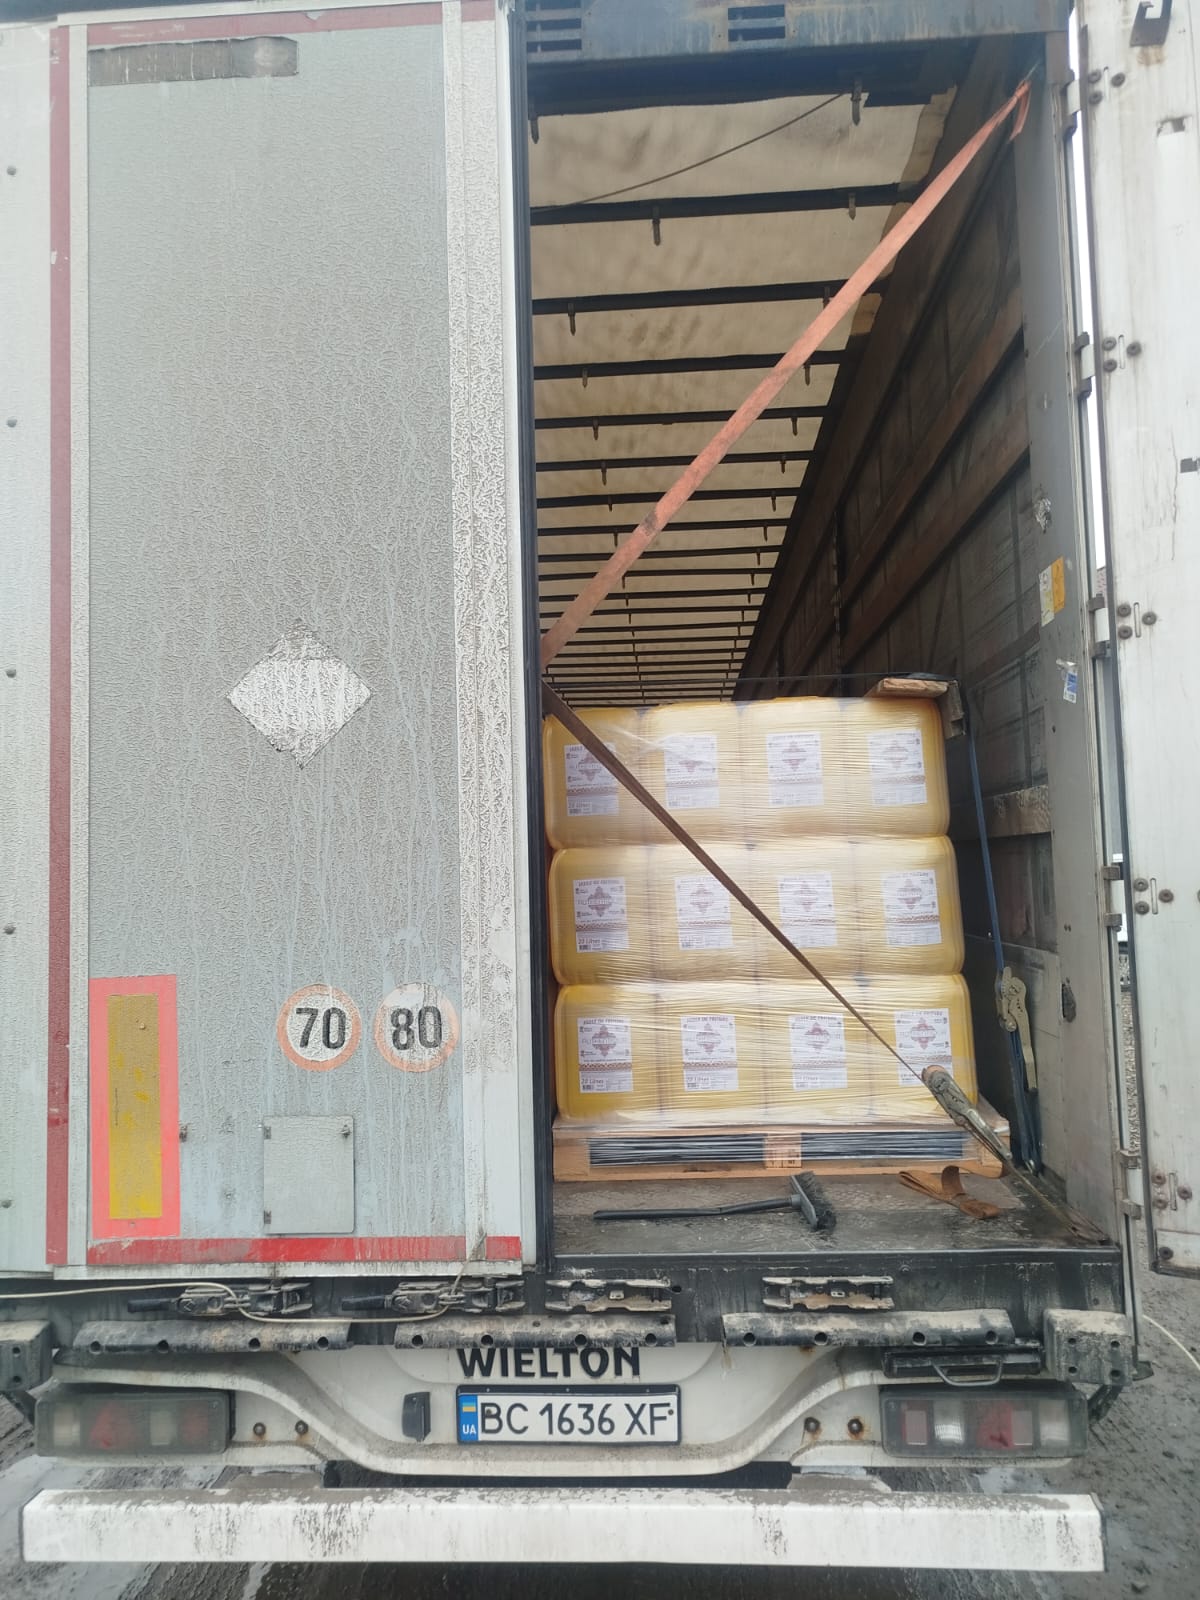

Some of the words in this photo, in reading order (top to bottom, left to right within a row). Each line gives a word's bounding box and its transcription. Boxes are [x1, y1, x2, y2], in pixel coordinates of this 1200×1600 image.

[296, 1007, 346, 1050] 70
[391, 1006, 442, 1051] 80
[457, 1348, 641, 1378] WIELTON
[462, 1425, 477, 1435] UA
[480, 1402, 529, 1435] BC
[539, 1403, 616, 1436] 1636
[624, 1402, 672, 1436] XF
